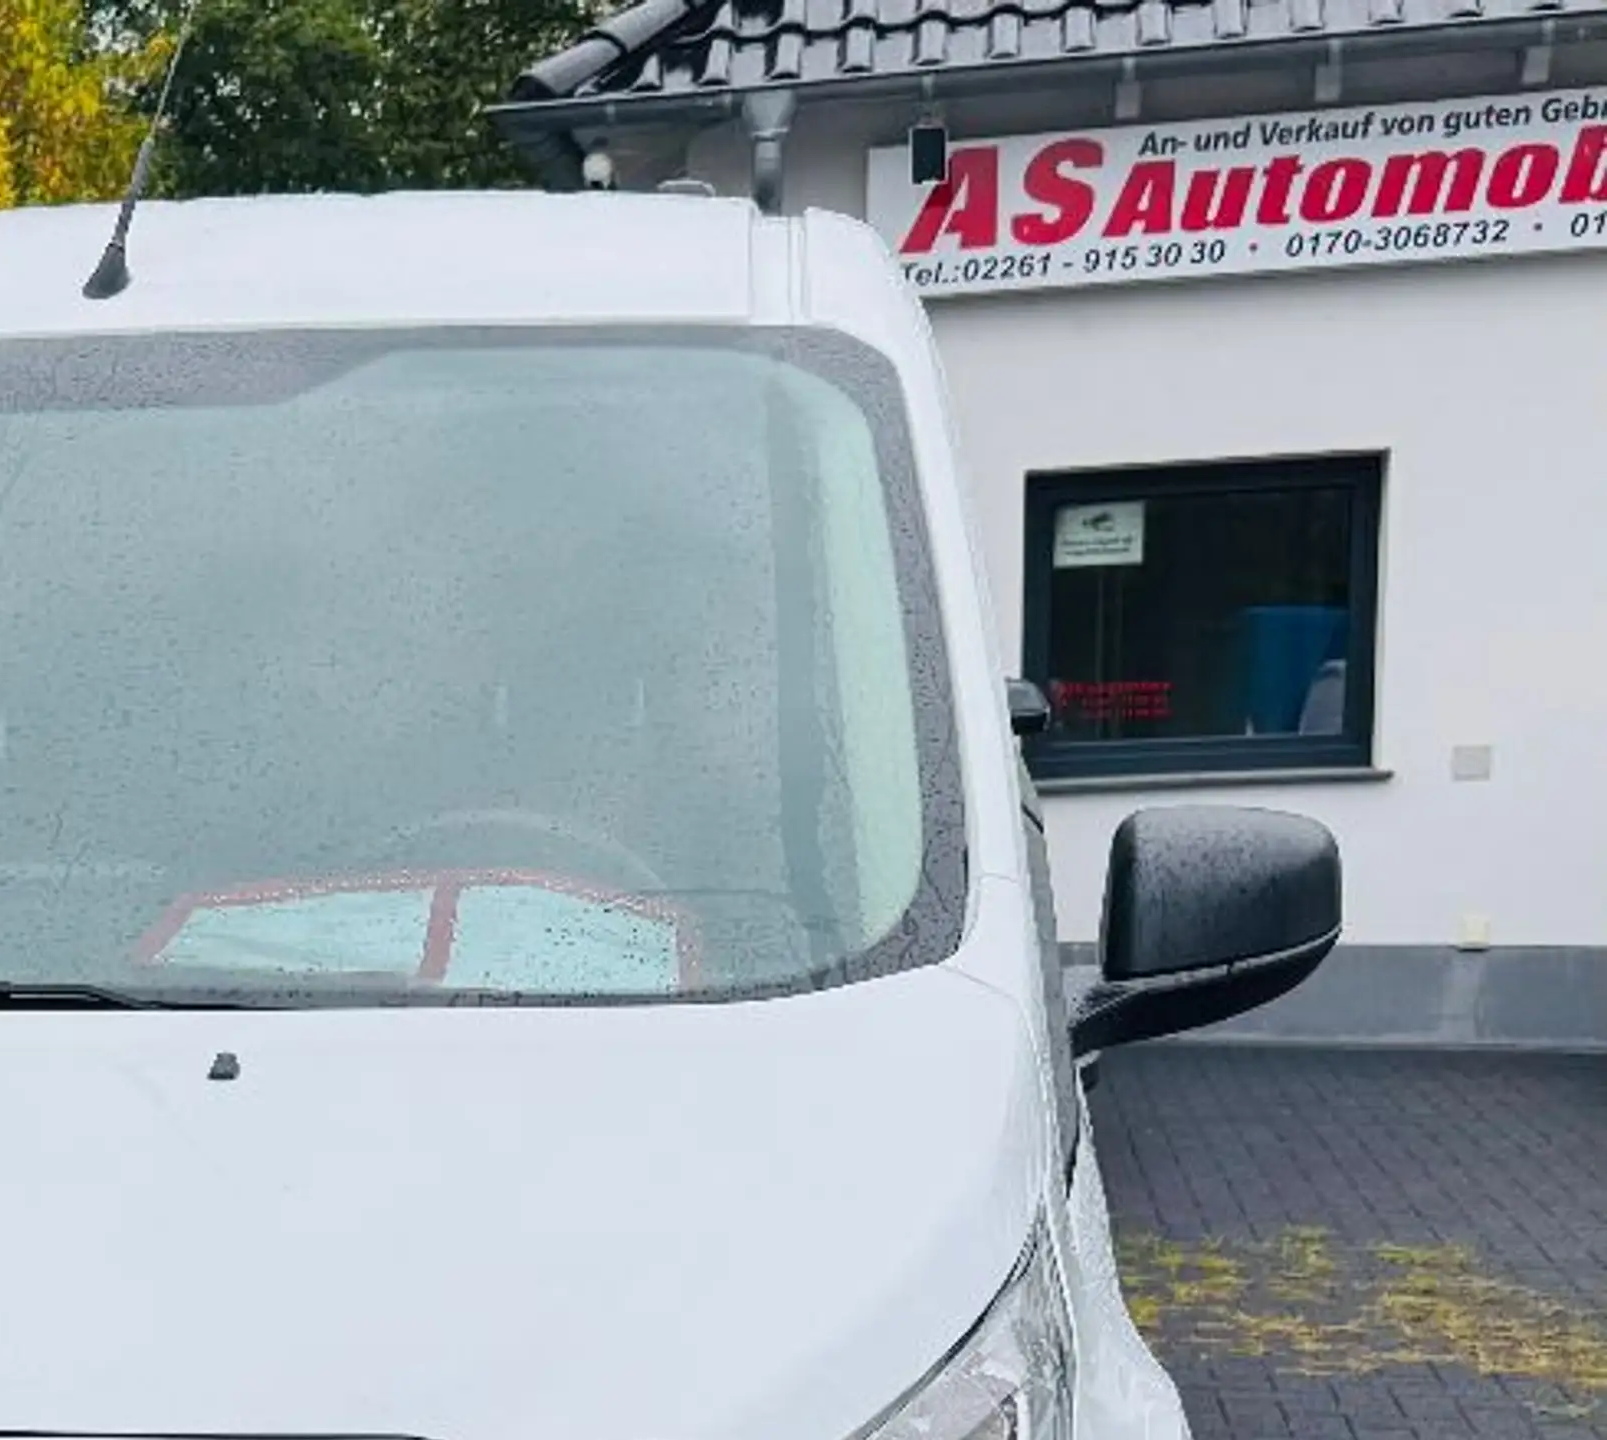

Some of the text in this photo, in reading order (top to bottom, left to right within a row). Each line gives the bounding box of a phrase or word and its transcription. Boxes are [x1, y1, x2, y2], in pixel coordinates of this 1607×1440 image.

[1137, 130, 1186, 156] An-
[1193, 128, 1250, 153] und
[1259, 112, 1375, 147] Verkauf
[1379, 111, 1435, 136] von
[1441, 104, 1532, 138] guten
[1142, 241, 1183, 269] 30
[1188, 238, 1227, 266] 30
[1285, 218, 1511, 258] 0170-3068732
